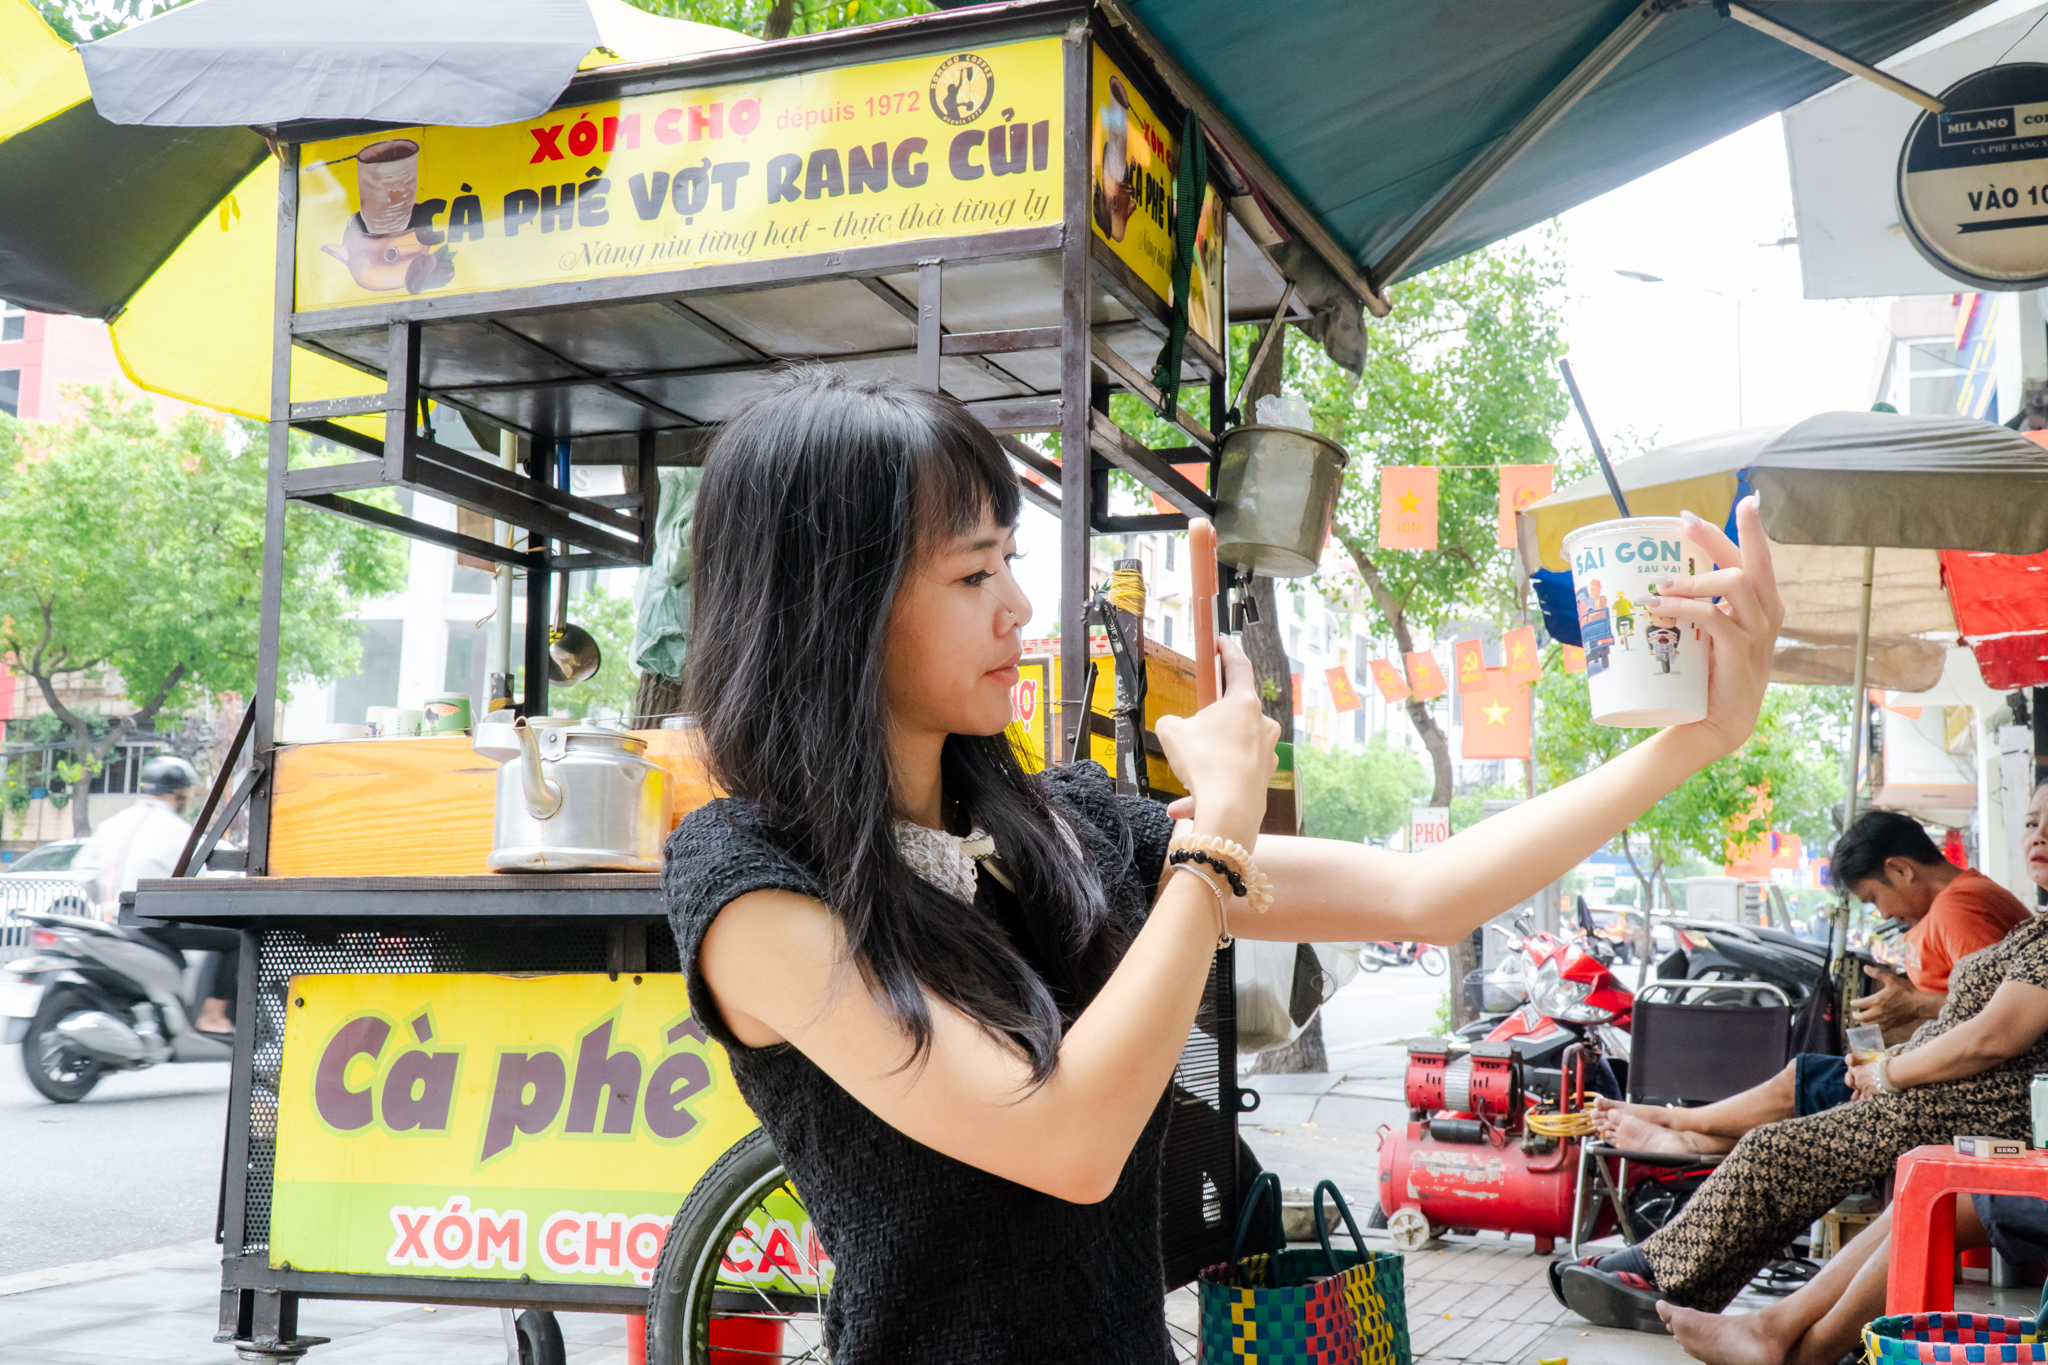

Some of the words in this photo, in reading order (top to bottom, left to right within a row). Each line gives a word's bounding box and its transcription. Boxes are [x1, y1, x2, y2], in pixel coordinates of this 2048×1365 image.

[965, 55, 993, 79] COFFEE
[529, 112, 641, 164] XÓM
[654, 97, 762, 144] CHỢ
[776, 102, 855, 134] dépuis
[865, 91, 920, 118] 1972
[1947, 117, 2009, 135] MILANO
[2011, 140, 2039, 151] RANG
[411, 182, 485, 246] CÀ
[504, 166, 611, 237] PHÊ
[628, 157, 750, 226] VỢT
[766, 137, 929, 204] RANG
[949, 107, 1050, 181] CỦI
[1968, 183, 2019, 211] VÀO
[559, 240, 648, 271] Nâng
[650, 236, 693, 260] niu
[698, 228, 757, 256] từng
[763, 217, 811, 250] hạt
[833, 211, 892, 241] thực
[900, 203, 945, 230] thà
[952, 198, 1016, 226] từng
[1023, 189, 1050, 221] ly
[1615, 536, 1681, 563] GÒN
[1637, 565, 1659, 574] SAU
[1662, 565, 1681, 574] VAI
[1414, 813, 1448, 843] PHỞ
[314, 1011, 460, 1132] Cà
[479, 1014, 712, 1164] phê
[1996, 1146, 2018, 1154] HERO
[394, 1203, 520, 1262] XÓM
[545, 1218, 672, 1281] CHỢ
